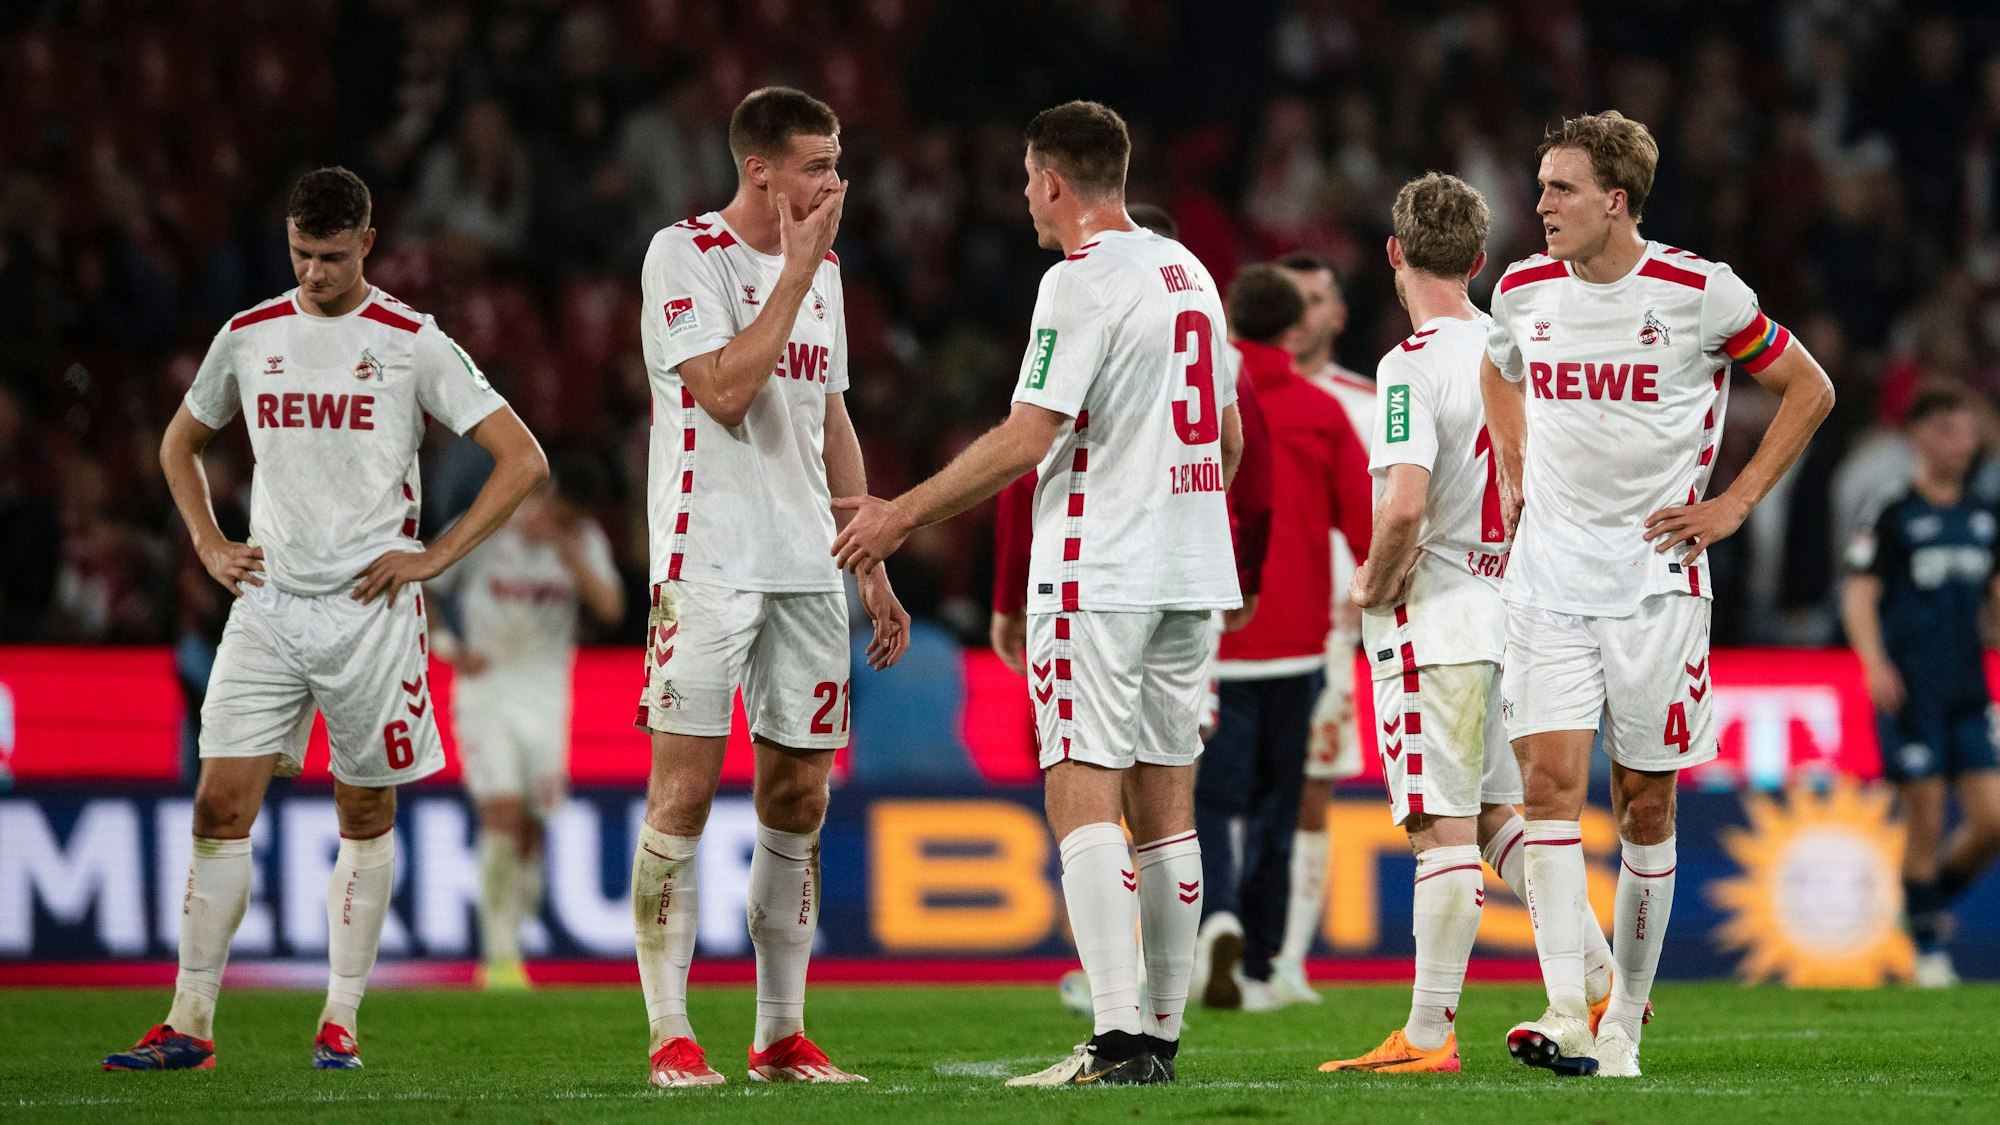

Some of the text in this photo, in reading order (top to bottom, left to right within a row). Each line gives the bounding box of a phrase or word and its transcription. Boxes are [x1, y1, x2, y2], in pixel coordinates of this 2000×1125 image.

[773, 342, 829, 385] EWE
[1030, 334, 1052, 384] DEVK
[1171, 310, 1219, 446] 3
[1529, 361, 1660, 402] REWE
[257, 392, 375, 431] REWE
[1391, 390, 1405, 438] DEVK
[1191, 457, 1223, 493] KÖL
[810, 679, 850, 734] 21
[1663, 701, 1691, 754] 4
[383, 719, 415, 771] 6
